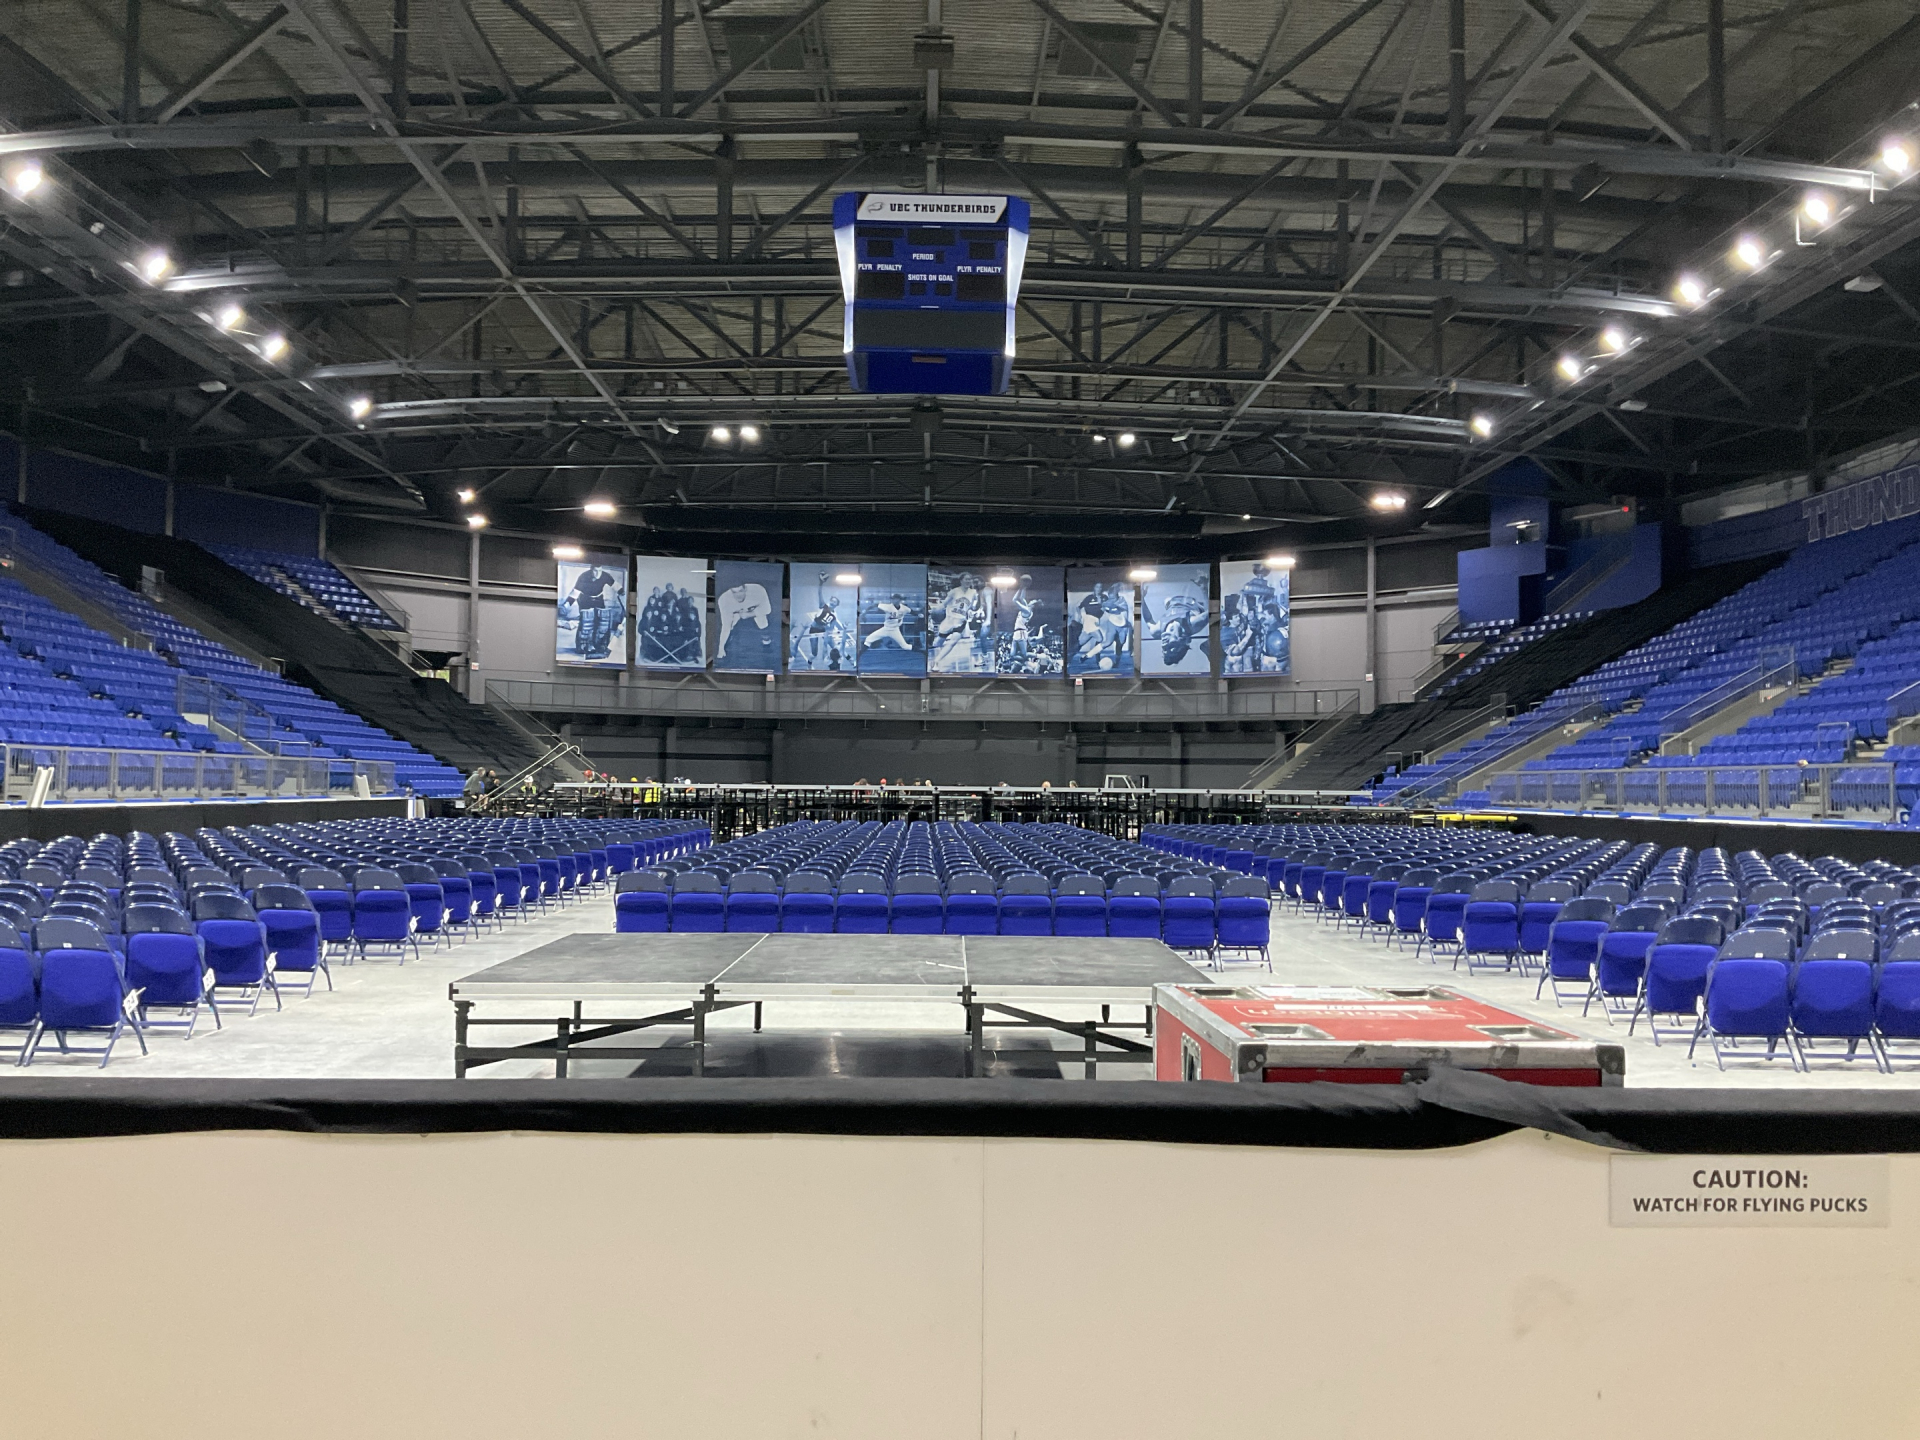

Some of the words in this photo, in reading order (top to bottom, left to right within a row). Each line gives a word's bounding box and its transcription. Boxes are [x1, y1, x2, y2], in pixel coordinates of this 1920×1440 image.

[890, 203, 910, 212] UBC
[914, 203, 996, 214] THUNDERBIRDS
[912, 253, 934, 261] PERIOD
[858, 263, 873, 271] PLYR
[877, 263, 902, 271] PENALTY
[957, 265, 972, 273] PLYR
[976, 265, 1002, 273] PENALTY
[938, 274, 954, 282] GOAL
[1692, 1169, 1809, 1189] CAUTION:
[1632, 1197, 1699, 1213] WATCH
[1703, 1197, 1738, 1213] FOR
[1742, 1197, 1805, 1213] FLYING
[1809, 1197, 1868, 1213] PUCKS
